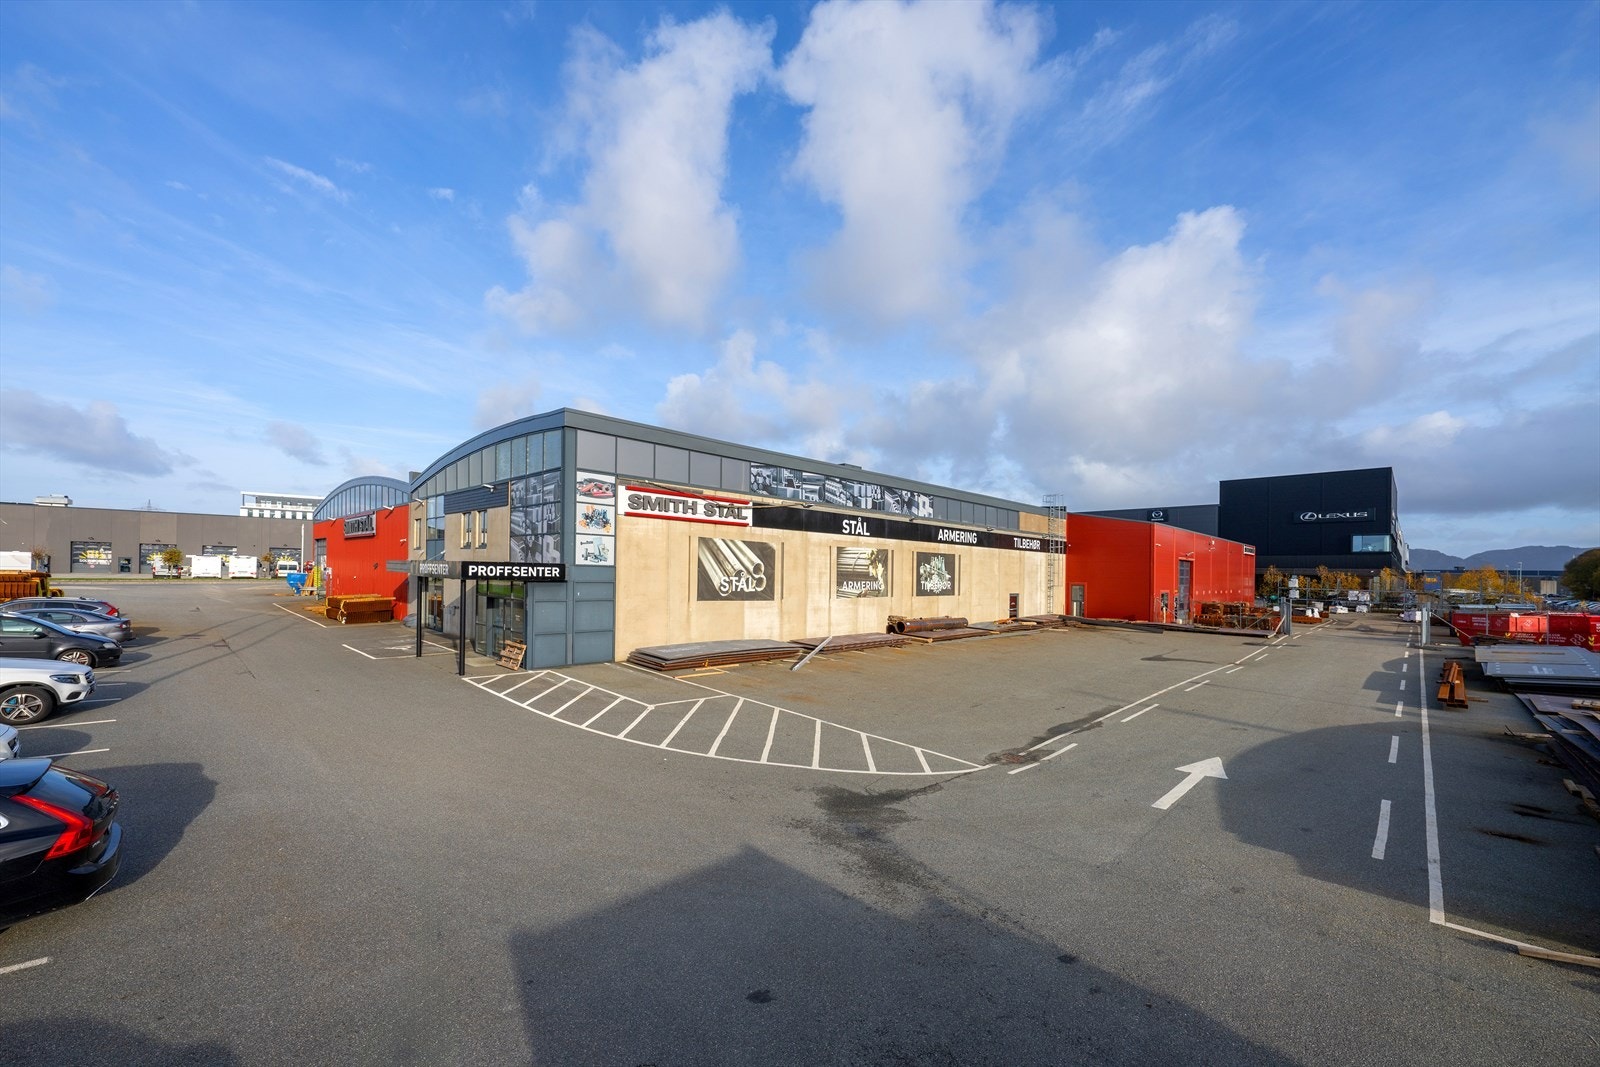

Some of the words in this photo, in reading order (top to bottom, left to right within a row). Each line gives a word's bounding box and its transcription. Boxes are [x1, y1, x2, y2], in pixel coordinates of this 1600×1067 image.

[628, 494, 698, 515] SMITH
[703, 502, 748, 520] STÅL
[1318, 511, 1368, 519] LEXUS
[842, 517, 870, 535] STÅL
[938, 529, 977, 544] ARMERING
[1014, 538, 1041, 550] TILBEHØR
[419, 563, 449, 575] PROFFSENTER
[468, 565, 560, 577] PROFFSENTER
[720, 571, 756, 592] STÅL
[842, 580, 884, 591] ARMERING
